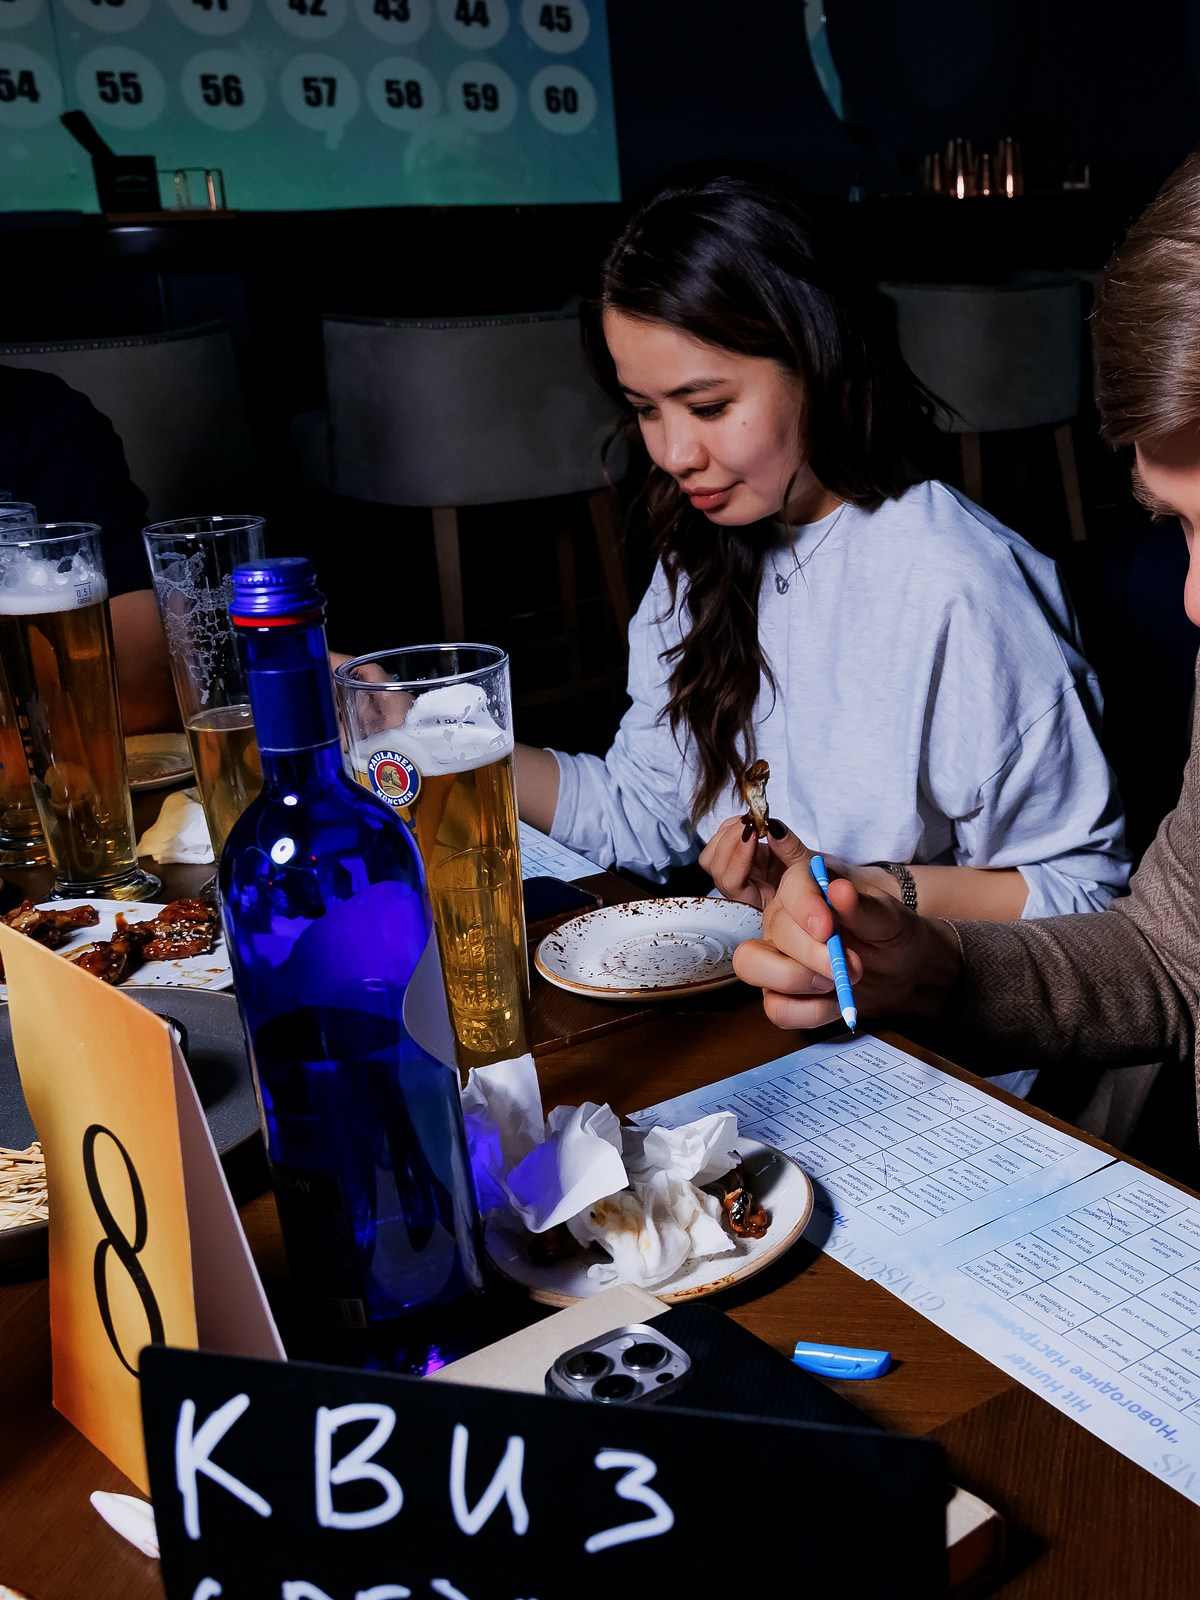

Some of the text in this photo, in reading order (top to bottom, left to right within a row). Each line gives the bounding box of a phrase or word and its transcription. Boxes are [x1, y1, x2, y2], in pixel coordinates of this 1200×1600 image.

[374, 0, 410, 21] 43
[456, 0, 489, 27] 44
[540, 5, 571, 32] 45
[0, 69, 578, 113] 54 55 56 57 58 59 60
[369, 751, 414, 773] PAULANER
[1059, 1225, 1095, 1248] Frank Sinatra
[1177, 1222, 1191, 1231] rock
[83, 1124, 167, 1379] 8
[1075, 1243, 1093, 1255] White
[1104, 1260, 1144, 1285] Chris Norman
[1120, 1260, 1147, 1277] Stumblin
[978, 1275, 1011, 1296] Somewhere
[991, 1273, 1015, 1289] memory
[1082, 1282, 1102, 1296] белых
[1038, 1292, 1067, 1312] Christmas
[1099, 1293, 1112, 1303] Три
[1167, 1296, 1198, 1315] Разговор
[1019, 1292, 1075, 1328] Queen Thank God
[1140, 1317, 1171, 1338] Проснись
[1076, 1327, 1132, 1363] Звенит Январская
[1180, 1347, 1195, 1357] про
[1137, 1361, 1154, 1372] wish
[1152, 1369, 1168, 1381] only
[1161, 1366, 1191, 1385] this year
[1003, 1353, 1092, 1413] Hit Hunter
[1137, 1371, 1184, 1402] Britney Spears
[1177, 1385, 1197, 1401] That's
[176, 1394, 674, 1552] КВИЗ
